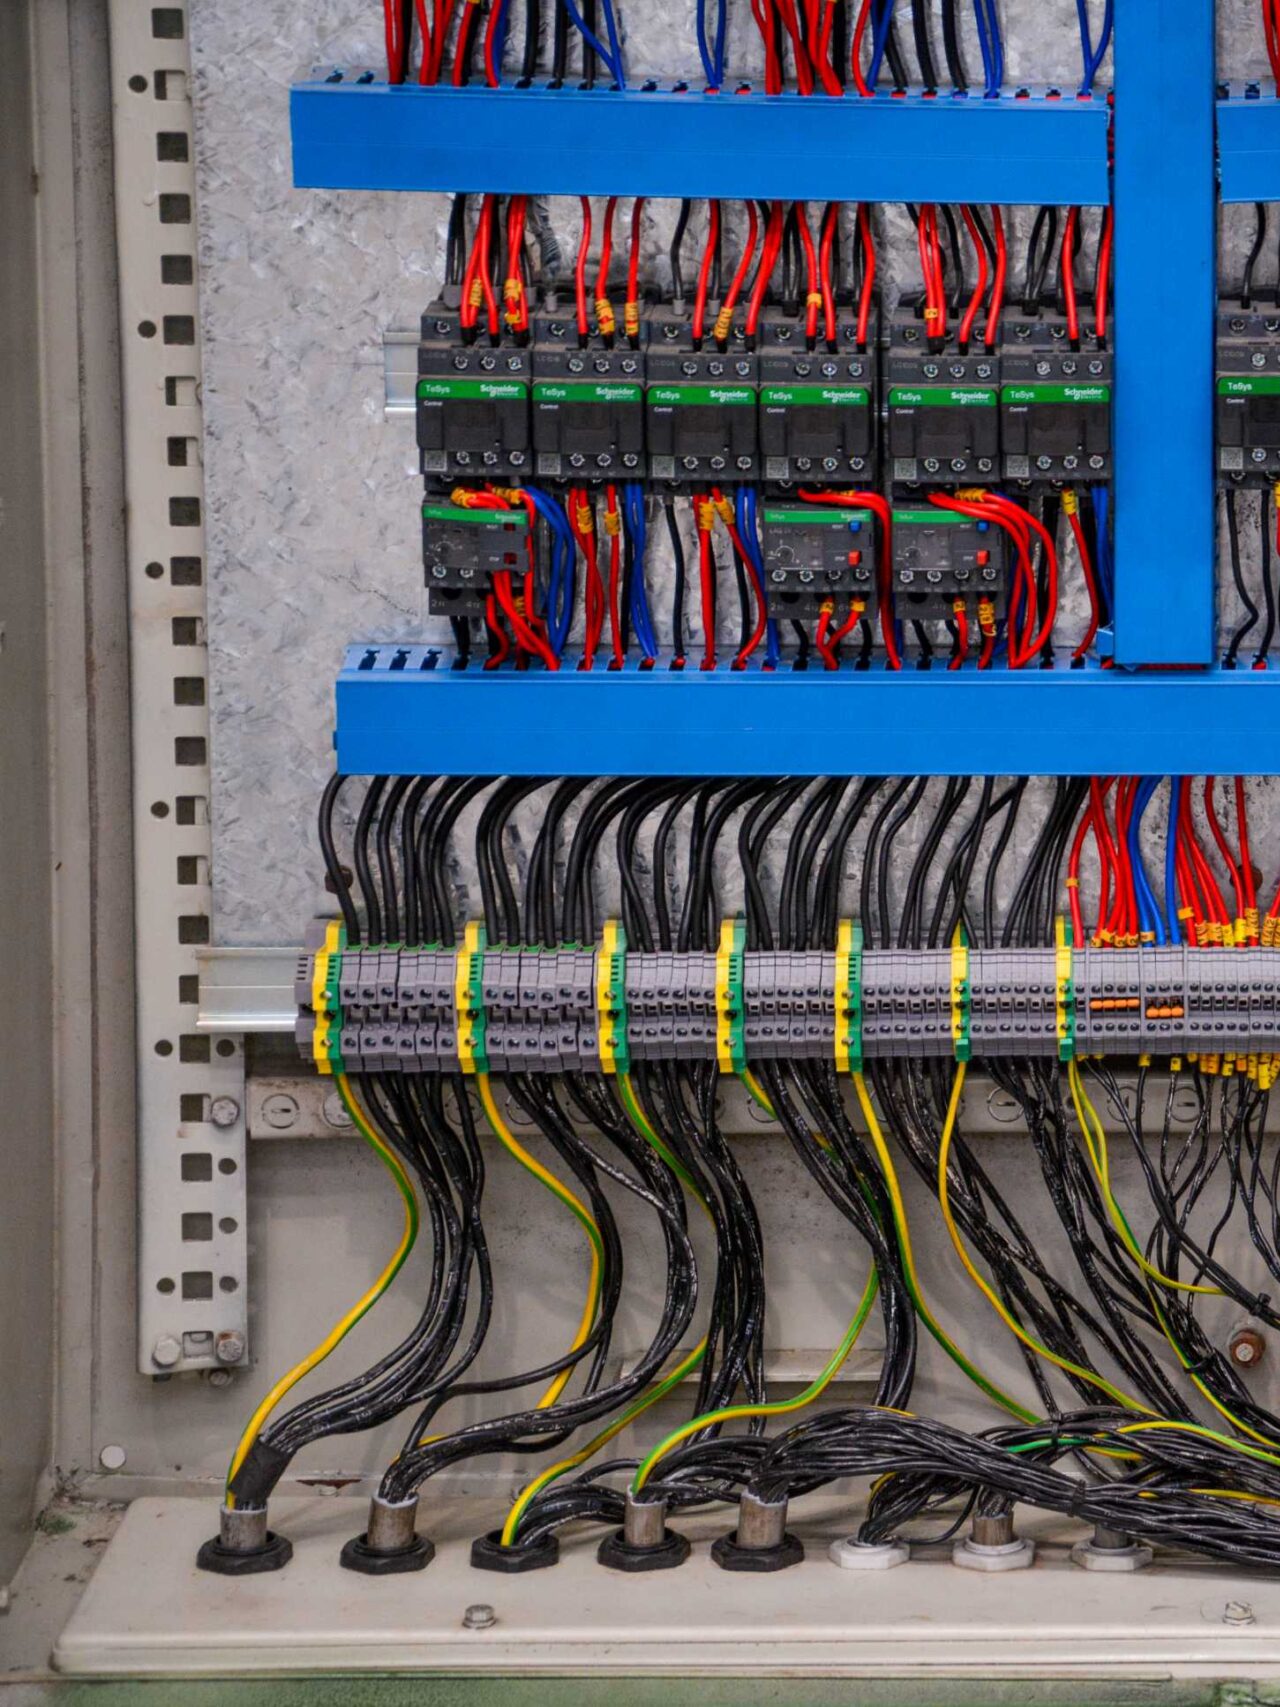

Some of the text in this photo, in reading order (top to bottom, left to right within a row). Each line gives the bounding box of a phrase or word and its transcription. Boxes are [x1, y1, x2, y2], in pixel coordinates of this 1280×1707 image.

[425, 384, 451, 394] TeSys
[480, 384, 520, 397] Schneider
[541, 387, 567, 398] TeSys
[1227, 382, 1252, 392] TeSys
[595, 387, 635, 400] Schneider
[655, 390, 681, 401] TeSys
[709, 389, 750, 403] Schneider
[768, 391, 793, 401] TeSys
[822, 390, 862, 403] Schneider
[897, 392, 922, 402] TeSys
[950, 391, 990, 404] Schneider
[1010, 390, 1035, 400] TeSys
[1064, 387, 1104, 400] Schneider
